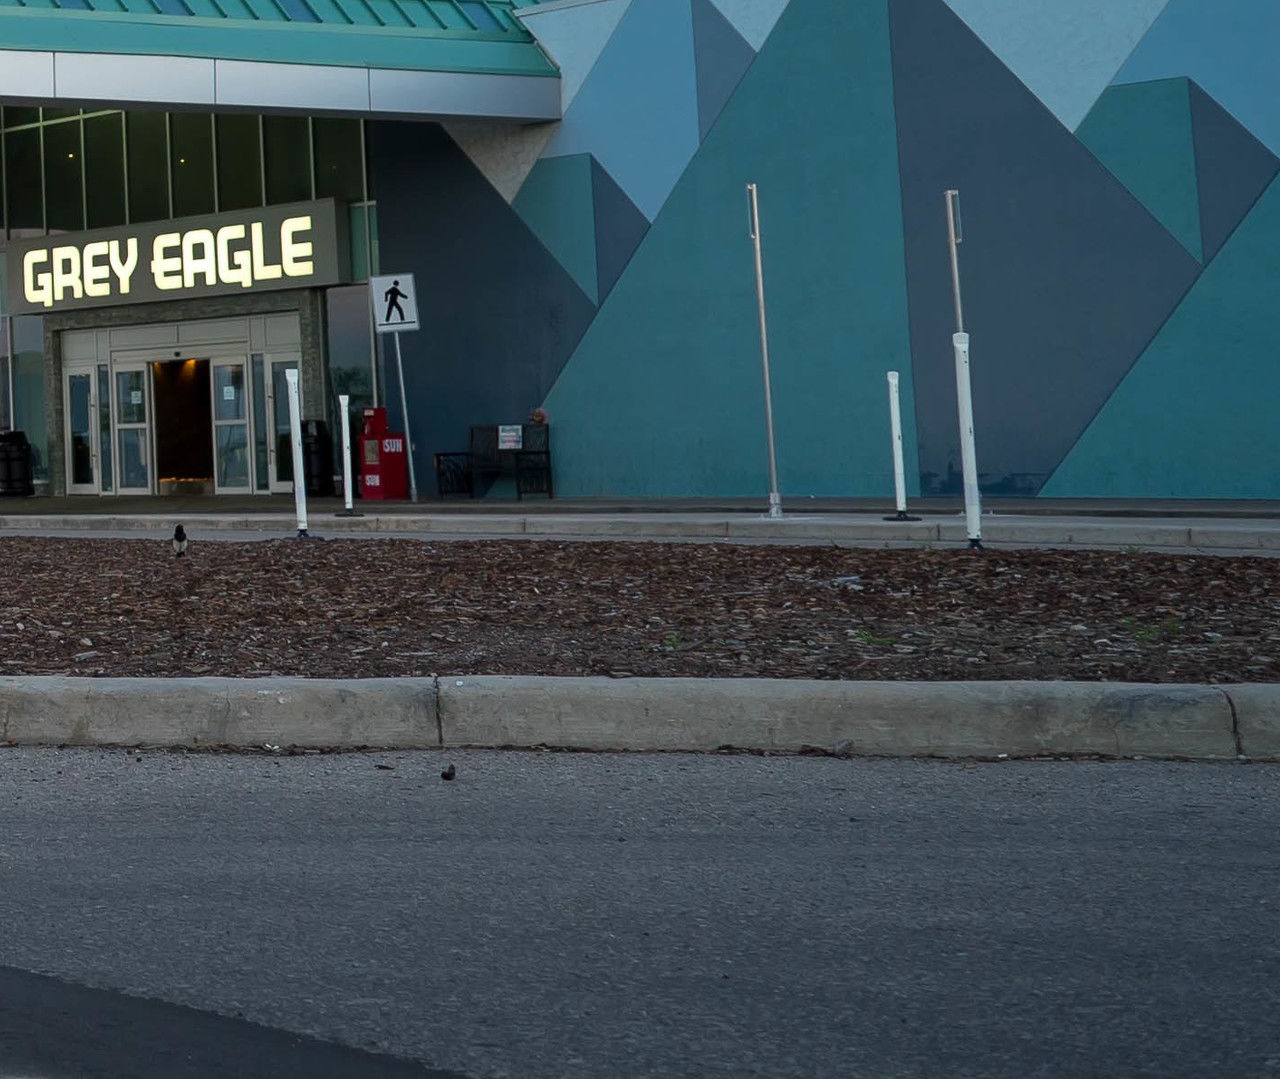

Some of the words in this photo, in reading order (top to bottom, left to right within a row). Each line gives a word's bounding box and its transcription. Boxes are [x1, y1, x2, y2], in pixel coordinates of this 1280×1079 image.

[23, 237, 138, 308] GREY
[150, 215, 314, 289] EAGLE
[383, 438, 402, 452] SUN
